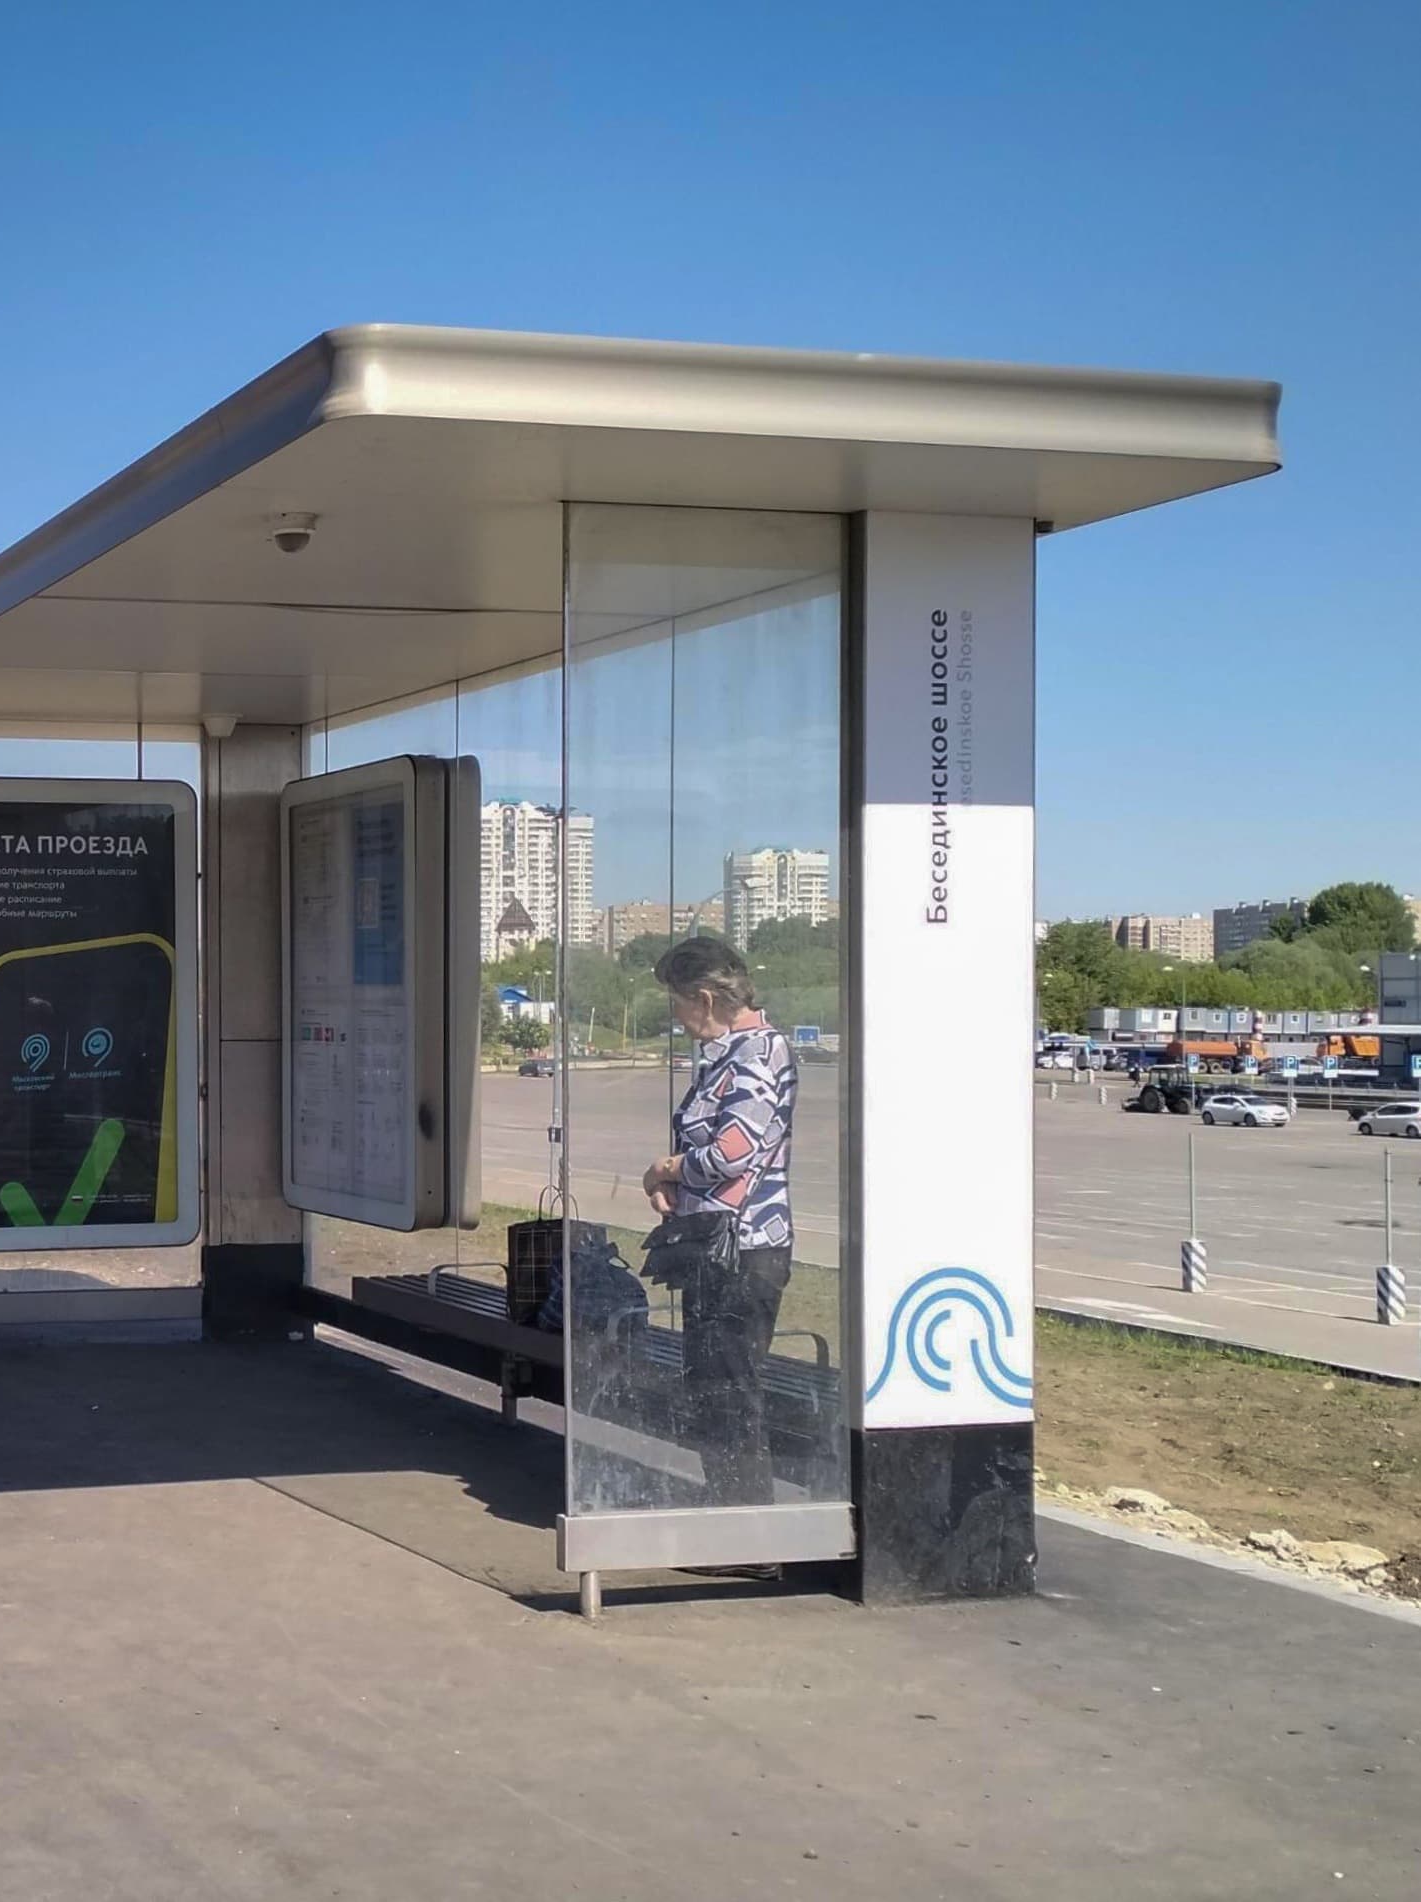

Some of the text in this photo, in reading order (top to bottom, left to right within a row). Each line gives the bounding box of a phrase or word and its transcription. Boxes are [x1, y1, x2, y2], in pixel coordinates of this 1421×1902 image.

[956, 609, 973, 807] esedinskoe Shosse
[926, 608, 952, 924] Бесединское шоссе
[37, 836, 148, 857] ПРОЕЗДА
[46, 866, 96, 877] страховой
[97, 868, 138, 877] выплаты
[12, 881, 65, 891] транспорта
[7, 896, 62, 905] расписание
[27, 909, 78, 920] маршруты
